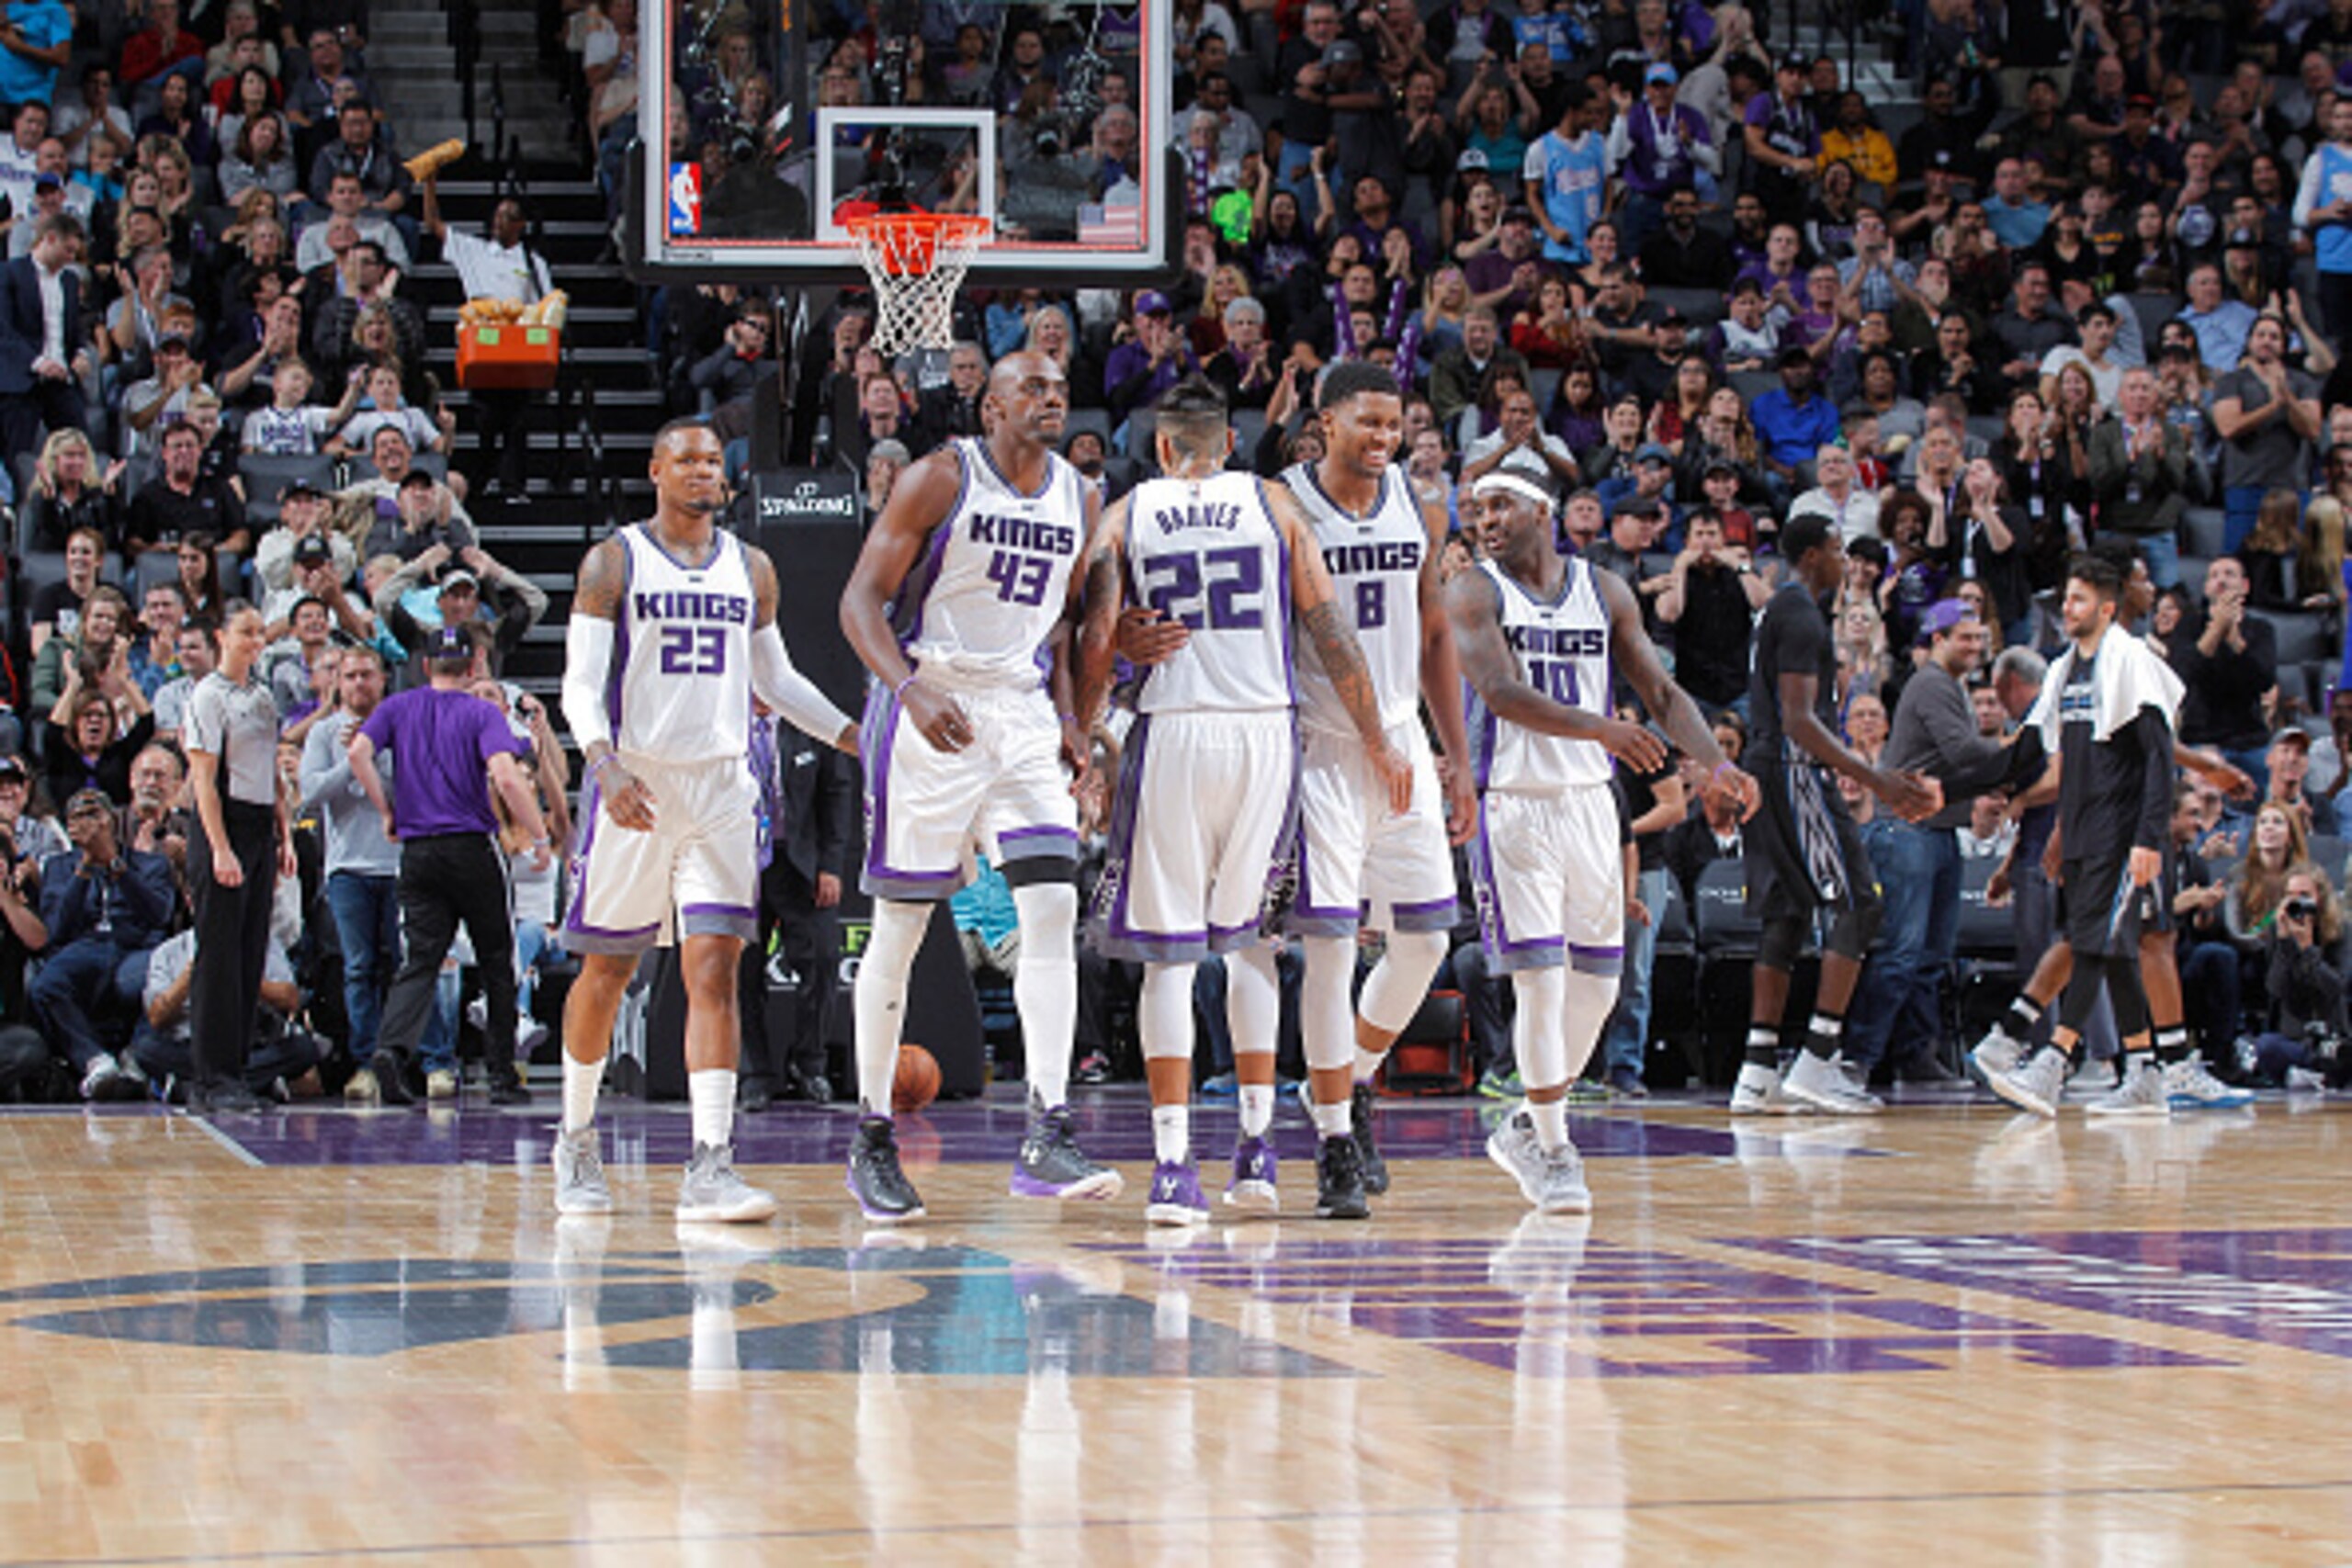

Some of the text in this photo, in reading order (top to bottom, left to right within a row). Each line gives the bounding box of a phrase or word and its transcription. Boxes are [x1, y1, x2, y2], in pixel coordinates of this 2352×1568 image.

[970, 513, 1074, 555] KINGS
[986, 549, 1054, 606] 43
[1143, 546, 1263, 629] 22
[635, 592, 747, 624] KINGS
[1357, 581, 1385, 629] 8
[661, 626, 726, 673] 23
[1503, 626, 1604, 656] KINGS
[1528, 660, 1580, 705] 10
